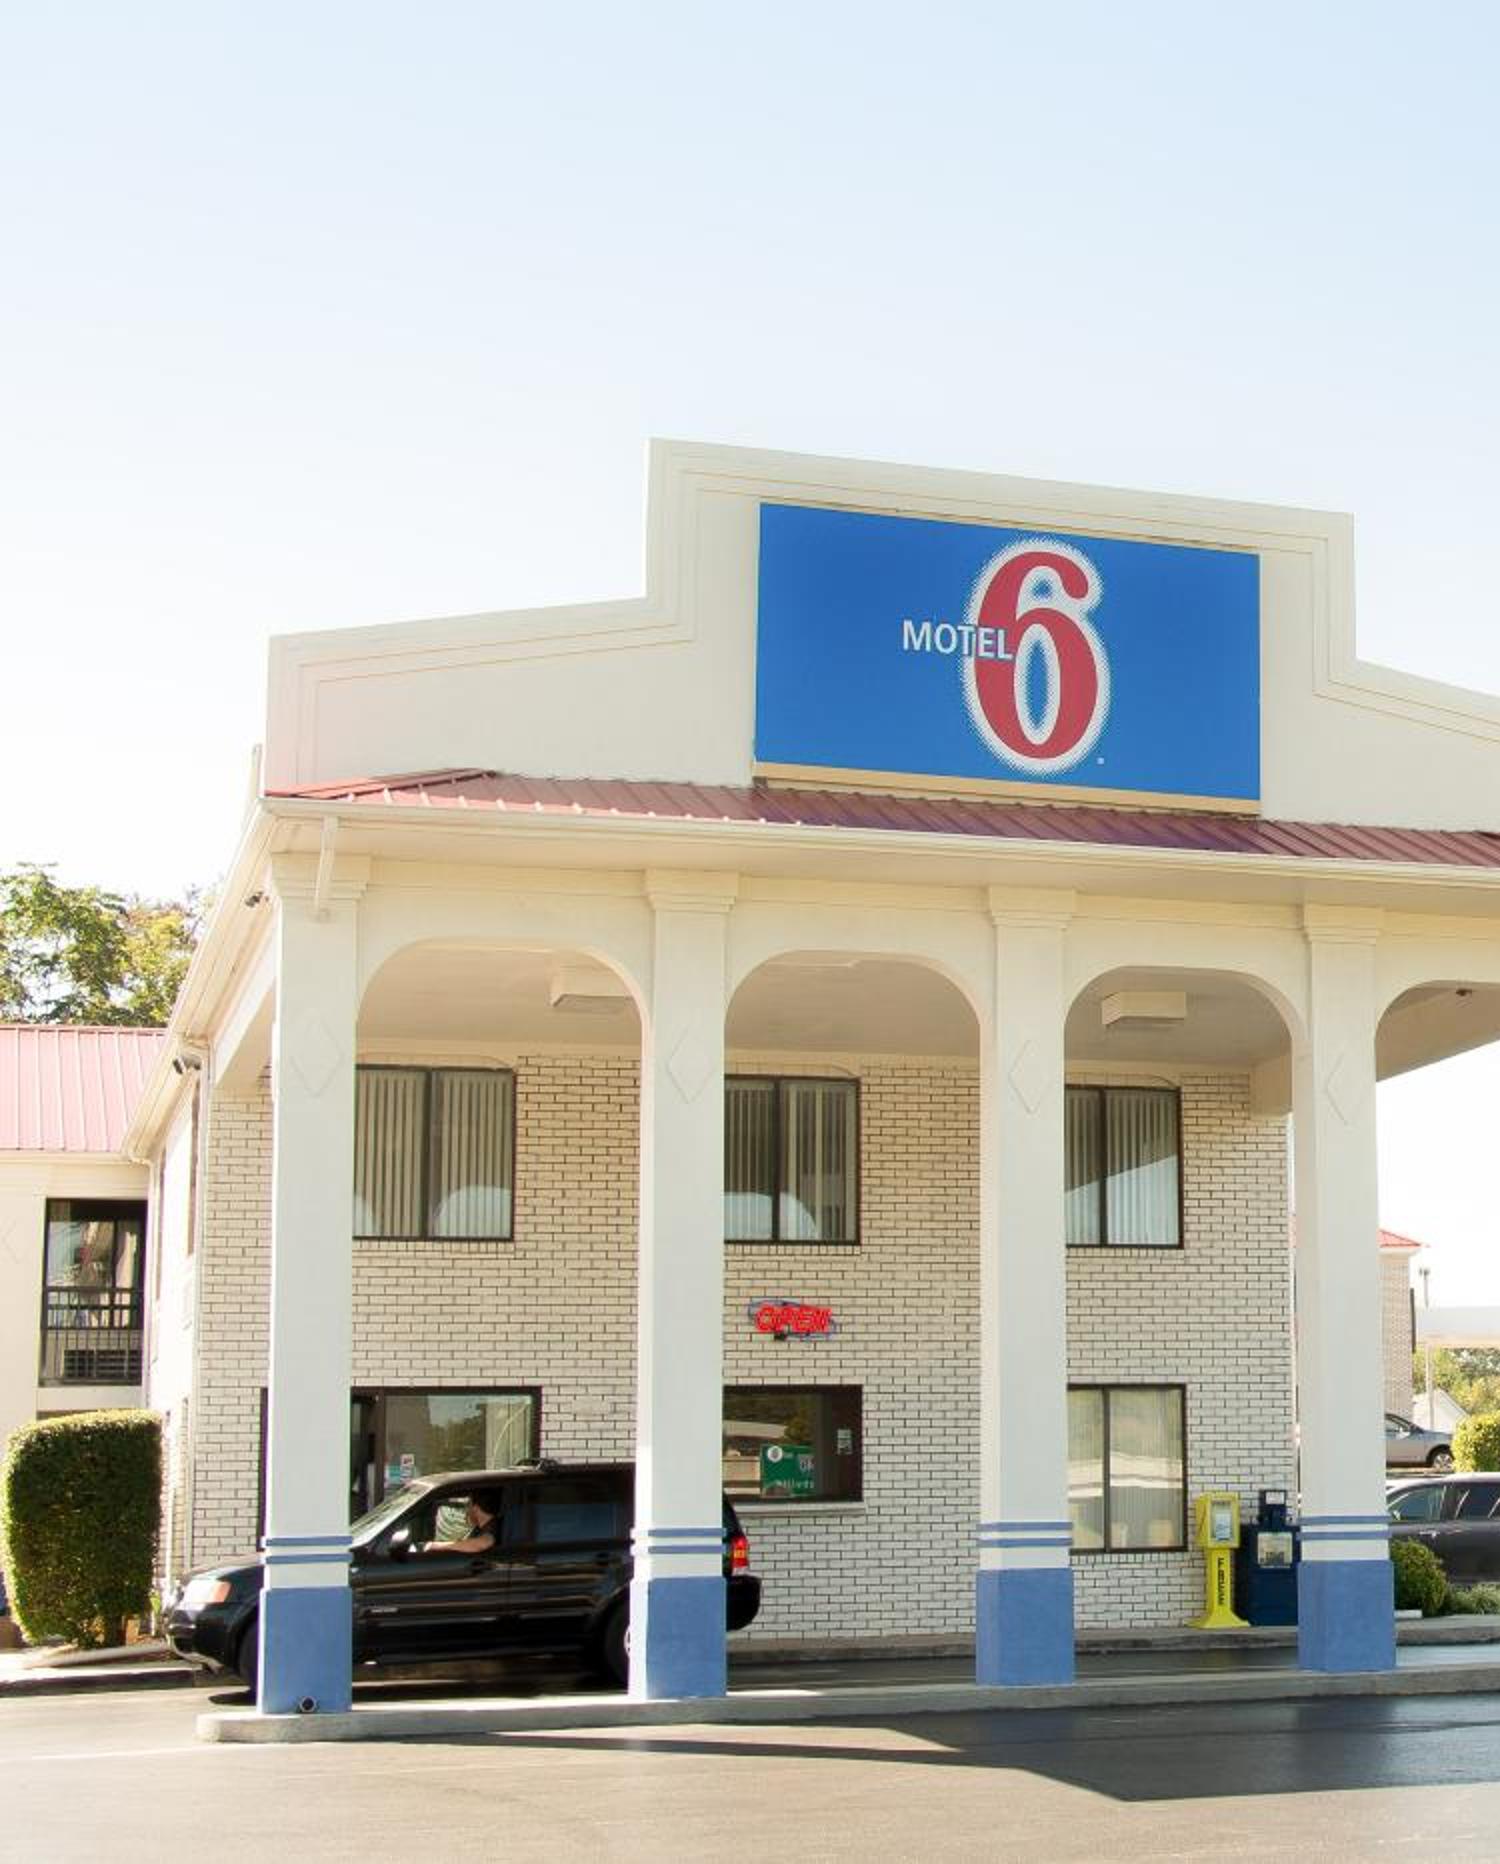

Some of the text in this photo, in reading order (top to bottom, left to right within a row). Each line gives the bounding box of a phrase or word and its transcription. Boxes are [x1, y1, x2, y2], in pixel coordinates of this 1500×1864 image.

[902, 543, 1104, 768] MOTEL 6
[755, 1303, 832, 1333] OPEN
